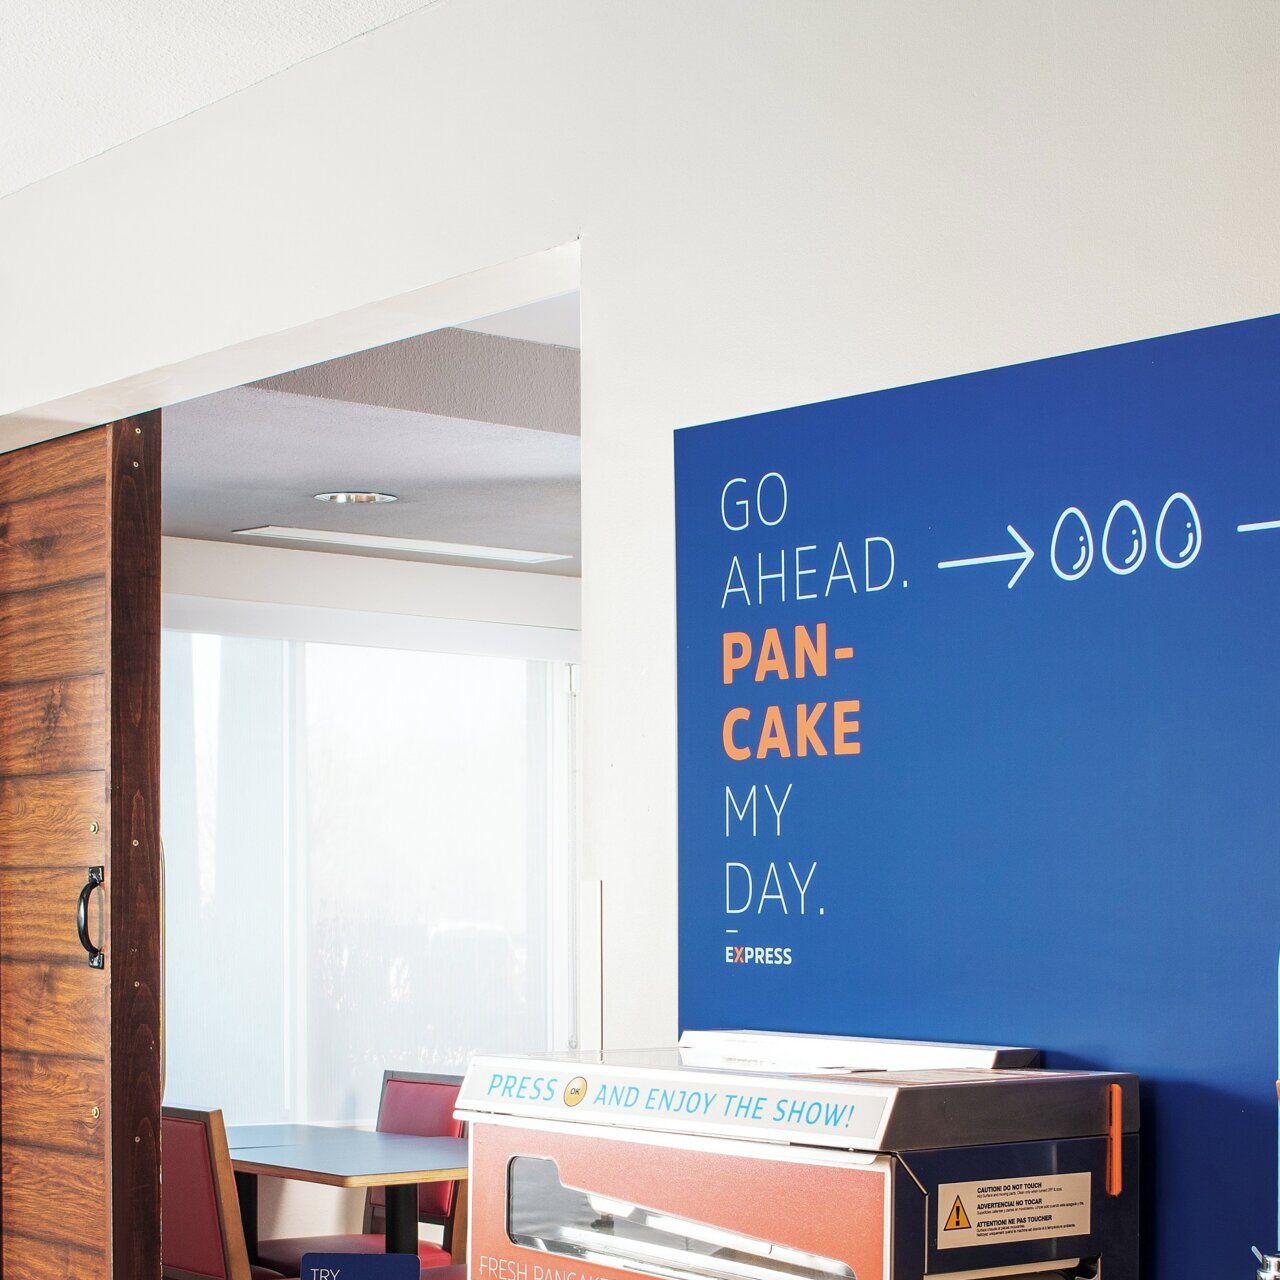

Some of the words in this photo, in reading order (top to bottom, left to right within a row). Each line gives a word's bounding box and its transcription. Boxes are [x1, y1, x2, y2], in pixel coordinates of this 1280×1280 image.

[721, 472, 788, 531] GO
[721, 536, 908, 608] AHEAD.
[722, 622, 855, 685] PAN-
[721, 699, 861, 761] CAKE
[725, 783, 793, 837] MY
[725, 861, 825, 915] DAY.
[725, 945, 793, 965] EXPRESS
[487, 1073, 558, 1101] PRESS
[570, 1087, 581, 1096] OK
[593, 1084, 640, 1108] AND
[645, 1088, 717, 1115] ENJOY
[723, 1094, 768, 1120] THE
[772, 1099, 856, 1128] SHOW!
[1016, 1216, 1027, 1224] PAS
[1027, 1214, 1053, 1222] TOUCHER
